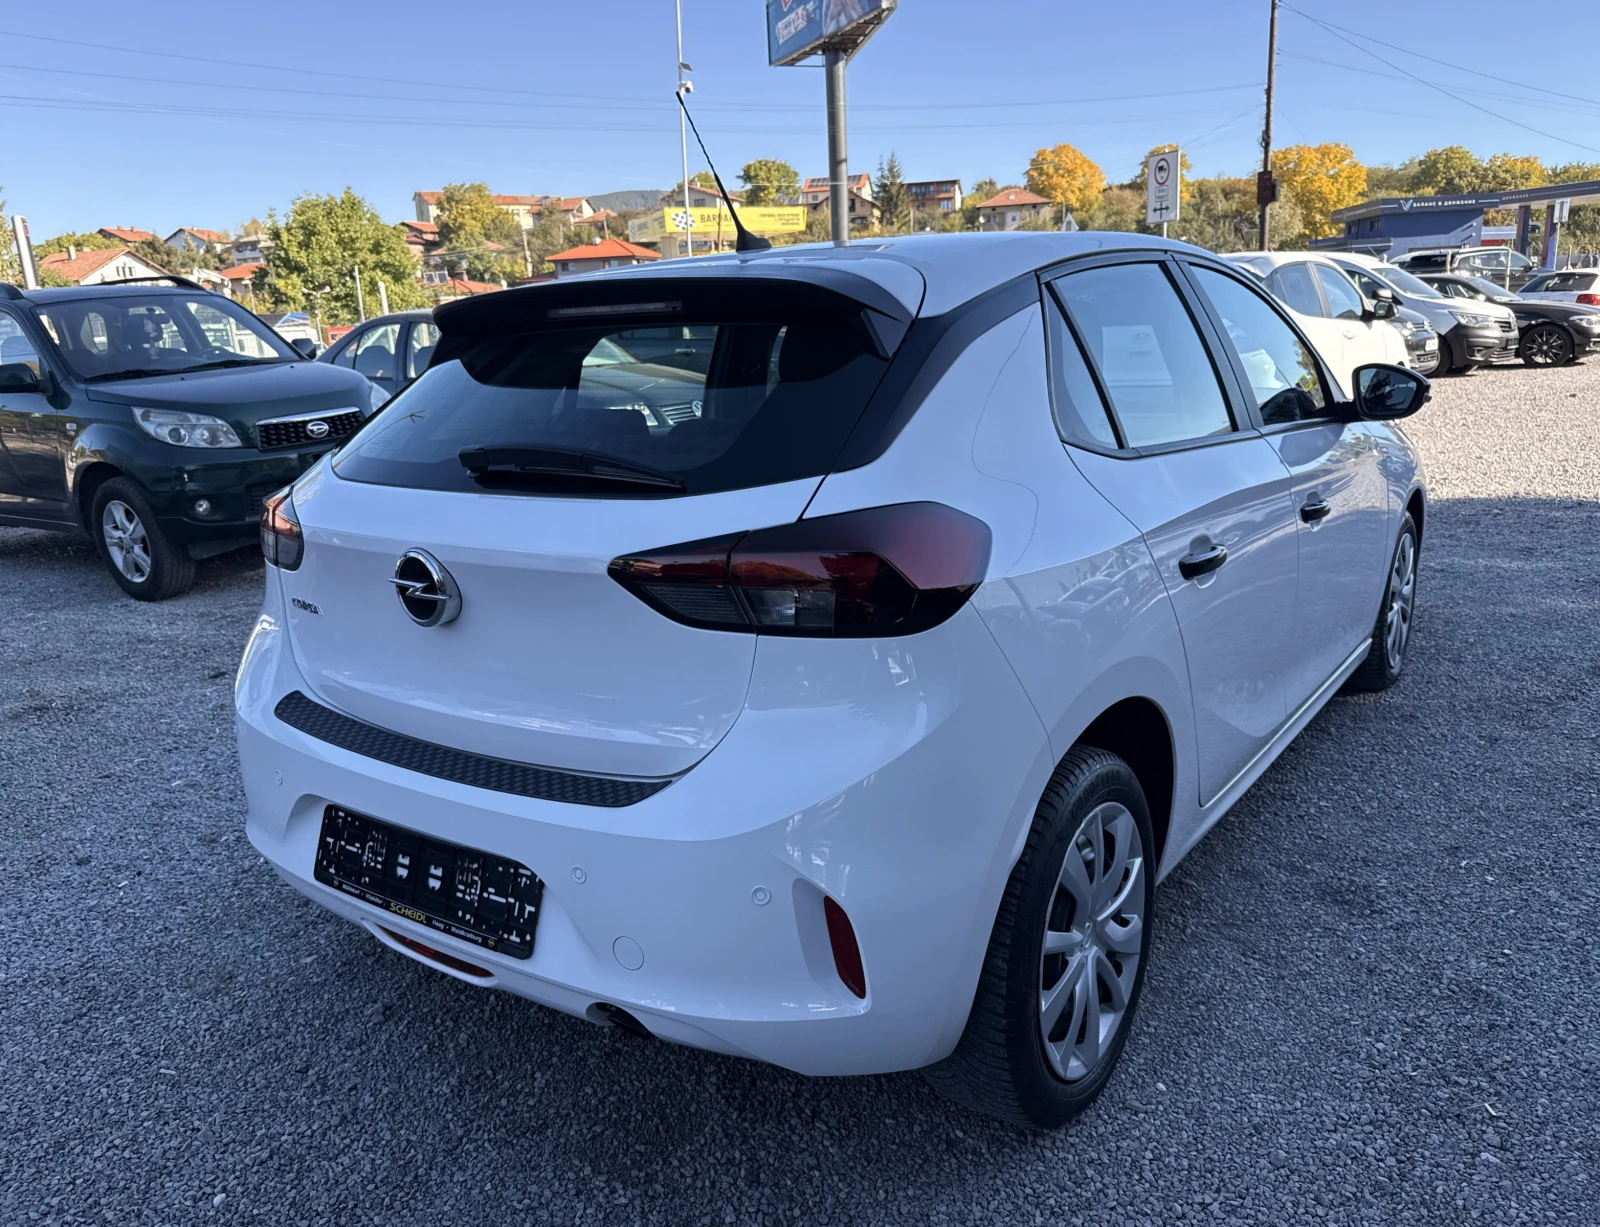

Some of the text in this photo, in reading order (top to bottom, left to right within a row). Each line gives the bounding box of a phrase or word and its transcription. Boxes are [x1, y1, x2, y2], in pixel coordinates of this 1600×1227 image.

[1071, 769, 1122, 820] GOODYEAR
[389, 902, 427, 924] SCHEIDL
[431, 919, 445, 930] Haag
[451, 926, 483, 944] Waldkraiburg
